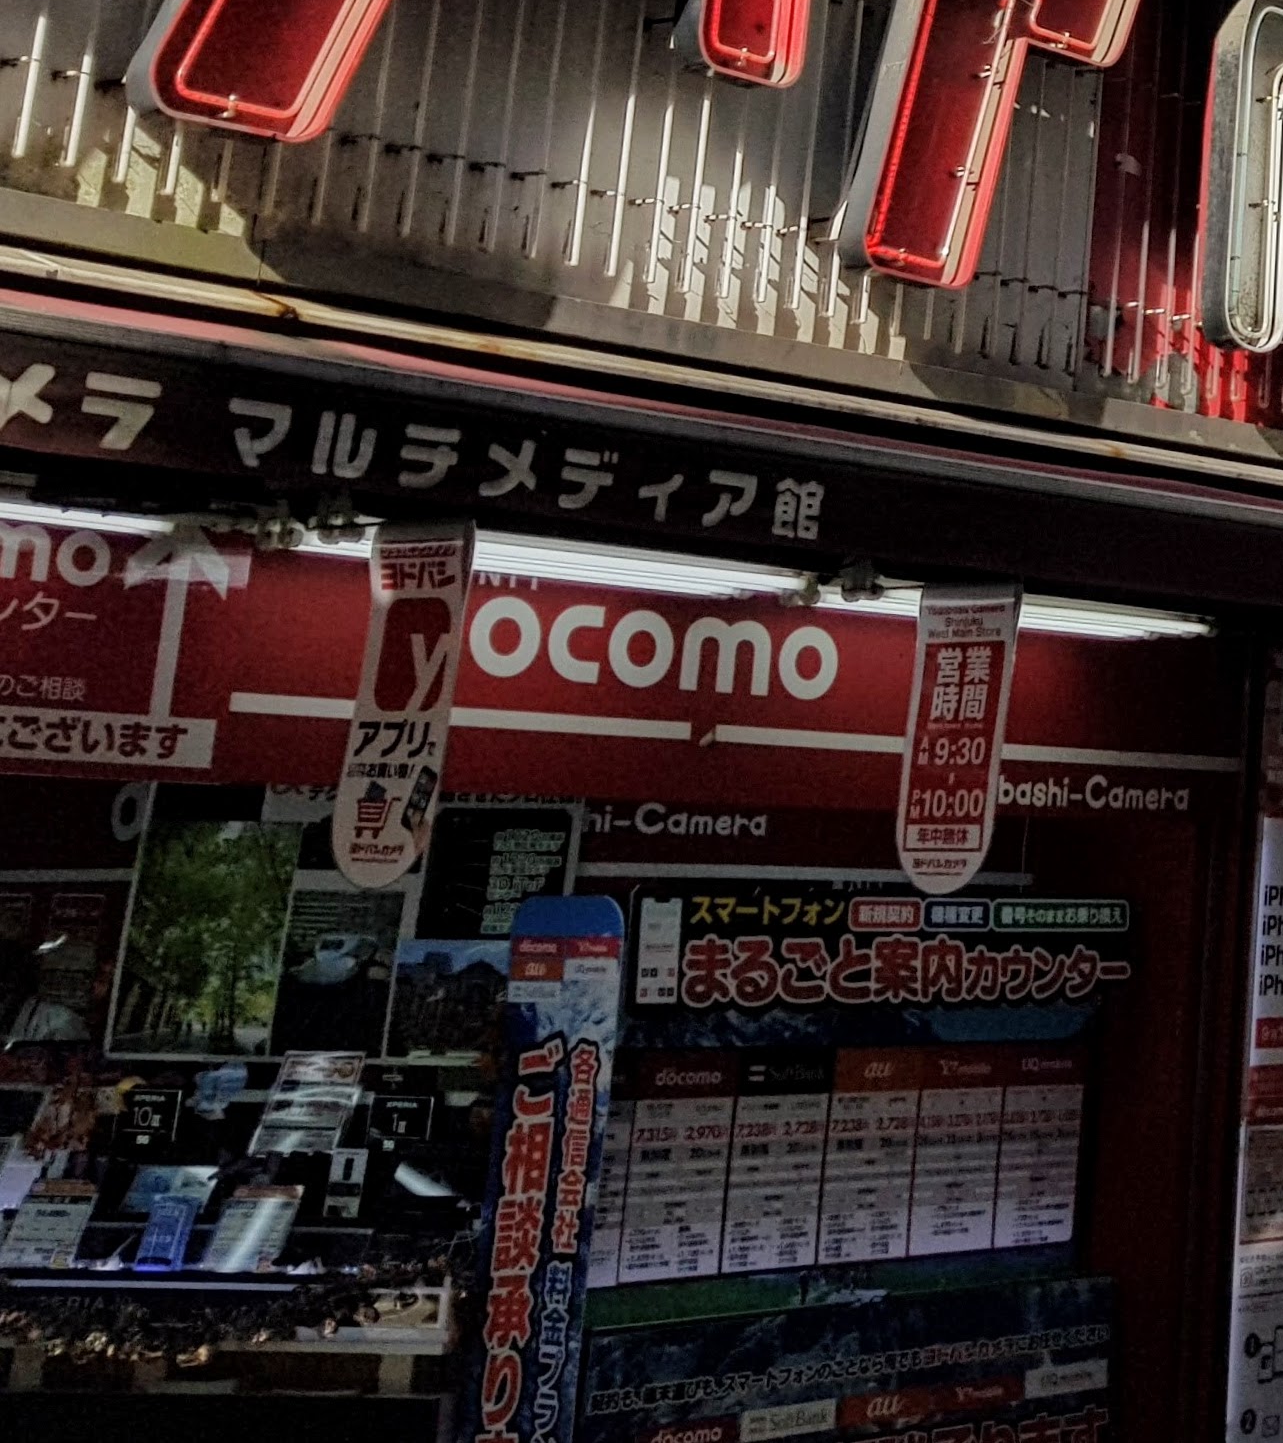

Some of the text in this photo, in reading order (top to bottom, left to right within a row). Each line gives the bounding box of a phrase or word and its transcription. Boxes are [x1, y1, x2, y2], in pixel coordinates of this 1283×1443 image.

[380, 560, 457, 591] ヨドバシ
[469, 595, 839, 701] ocomo
[353, 719, 435, 760] アプリで
[934, 737, 987, 766] 9:30
[922, 788, 985, 818] 10:00
[997, 774, 1190, 811] bashi-Camera
[689, 896, 846, 926] スマートフォン
[682, 934, 1132, 1008] まるごと案内カウンター
[654, 1066, 723, 1087] docomo
[863, 1061, 893, 1079] au
[478, 1038, 566, 1443] ご相談承り
